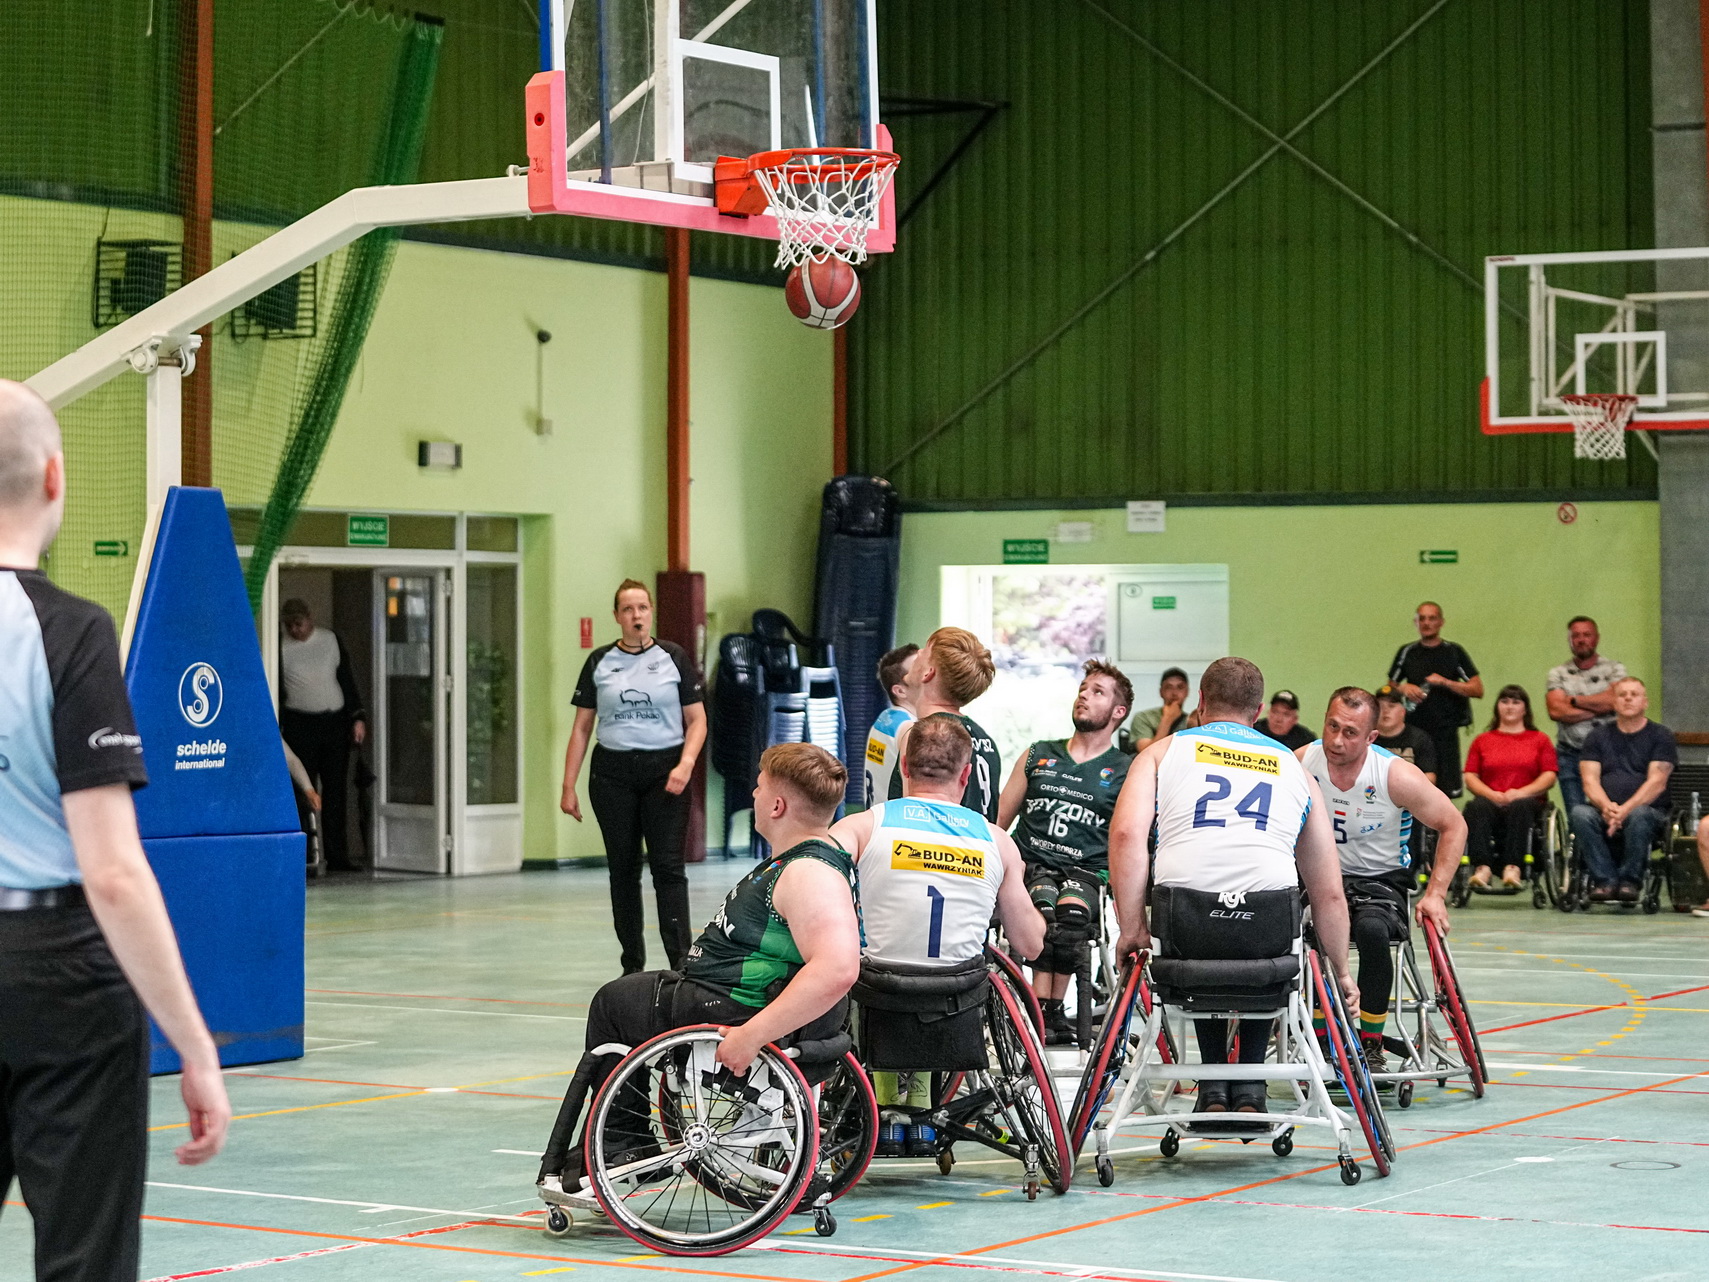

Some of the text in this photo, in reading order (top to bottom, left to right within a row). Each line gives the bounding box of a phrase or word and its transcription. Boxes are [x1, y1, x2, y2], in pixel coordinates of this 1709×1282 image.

[176, 739, 227, 757] schelde
[175, 758, 225, 771] international
[1223, 751, 1278, 768] BUD-AN
[1223, 760, 1278, 774] WAWRZYNIAK
[1040, 784, 1094, 801] ORTO MEDICO
[1192, 773, 1273, 832] 24
[1047, 813, 1070, 838] 16
[923, 849, 983, 867] BUD-AN
[923, 862, 982, 876] WAWRZYNIAK
[927, 885, 945, 958] 1
[1209, 909, 1255, 920] ELITE
